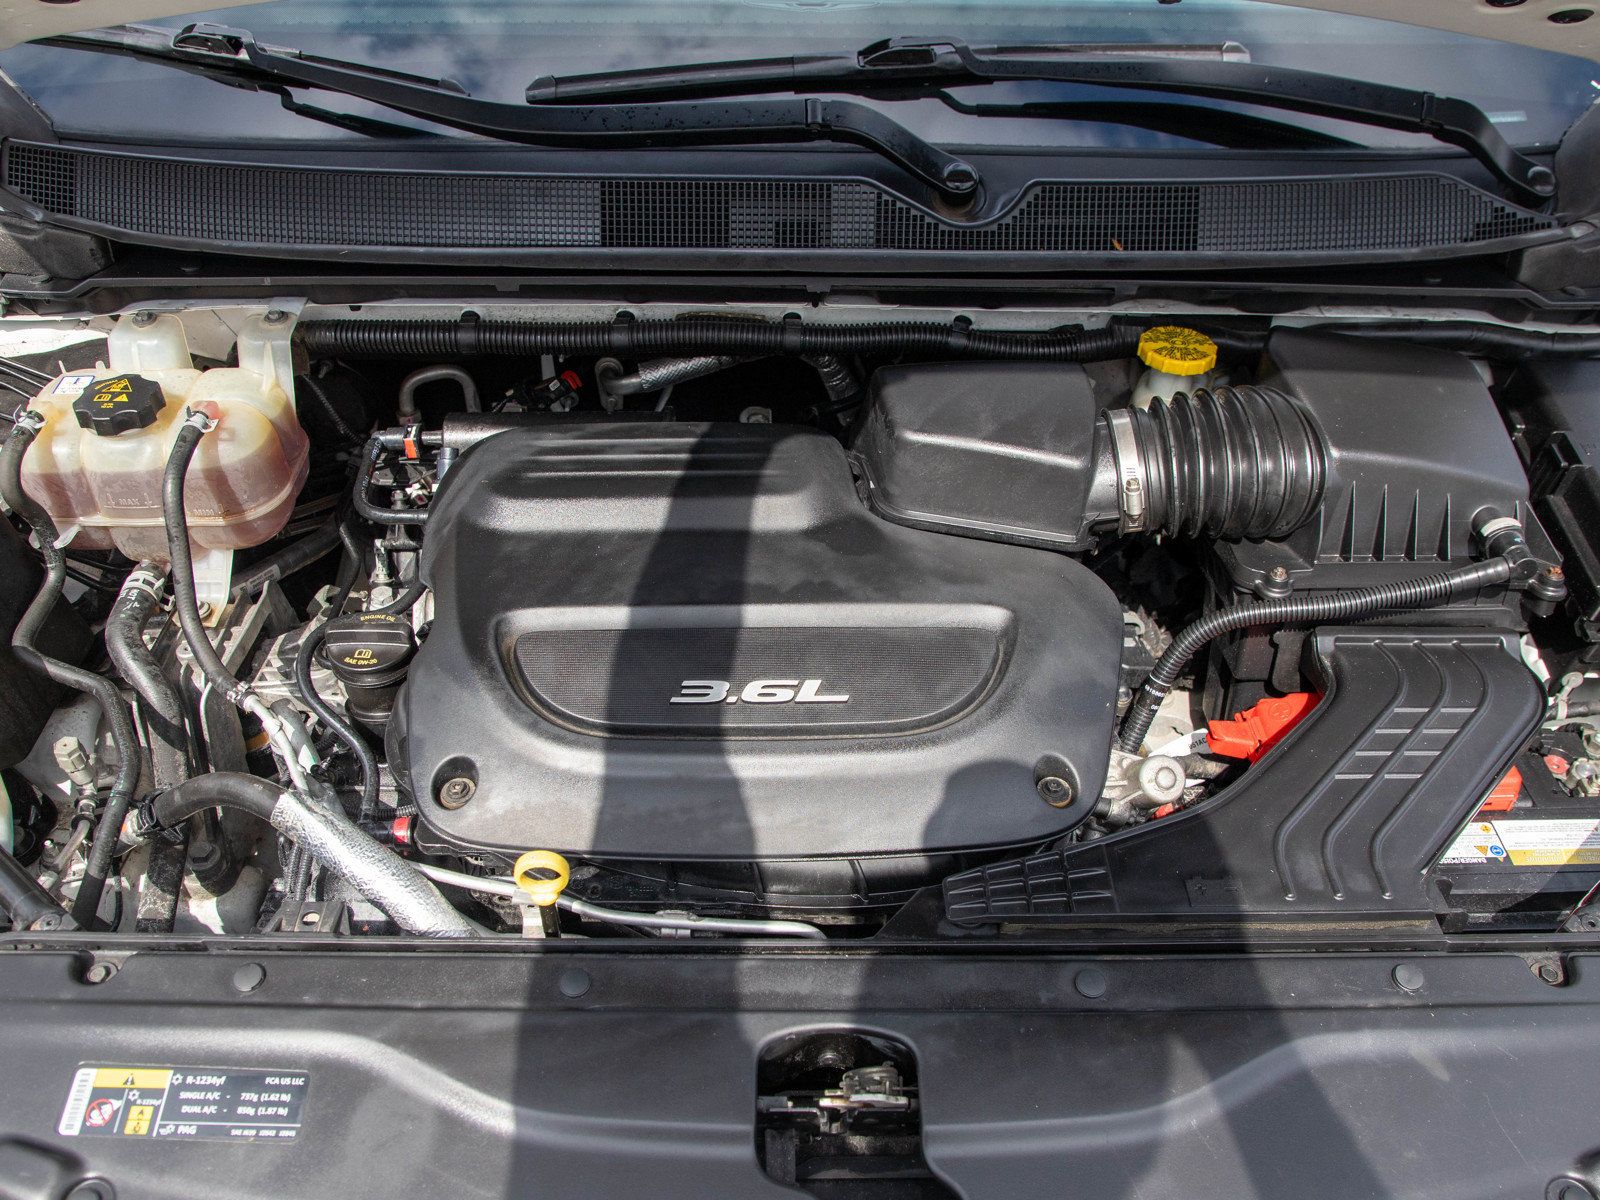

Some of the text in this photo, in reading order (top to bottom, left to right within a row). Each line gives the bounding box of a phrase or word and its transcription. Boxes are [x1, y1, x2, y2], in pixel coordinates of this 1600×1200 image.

[361, 614, 385, 622] ENGINE
[344, 657, 377, 666] SAE 0W-20
[669, 680, 850, 705] 3.6L
[185, 1075, 227, 1087] R-1234yf
[264, 1077, 306, 1086] FCA US LLC
[178, 1091, 205, 1100] SINGLE
[205, 1091, 221, 1100] A/C
[181, 1105, 202, 1114] DUAL
[202, 1106, 218, 1114] A/C
[177, 1125, 198, 1135] PAG
